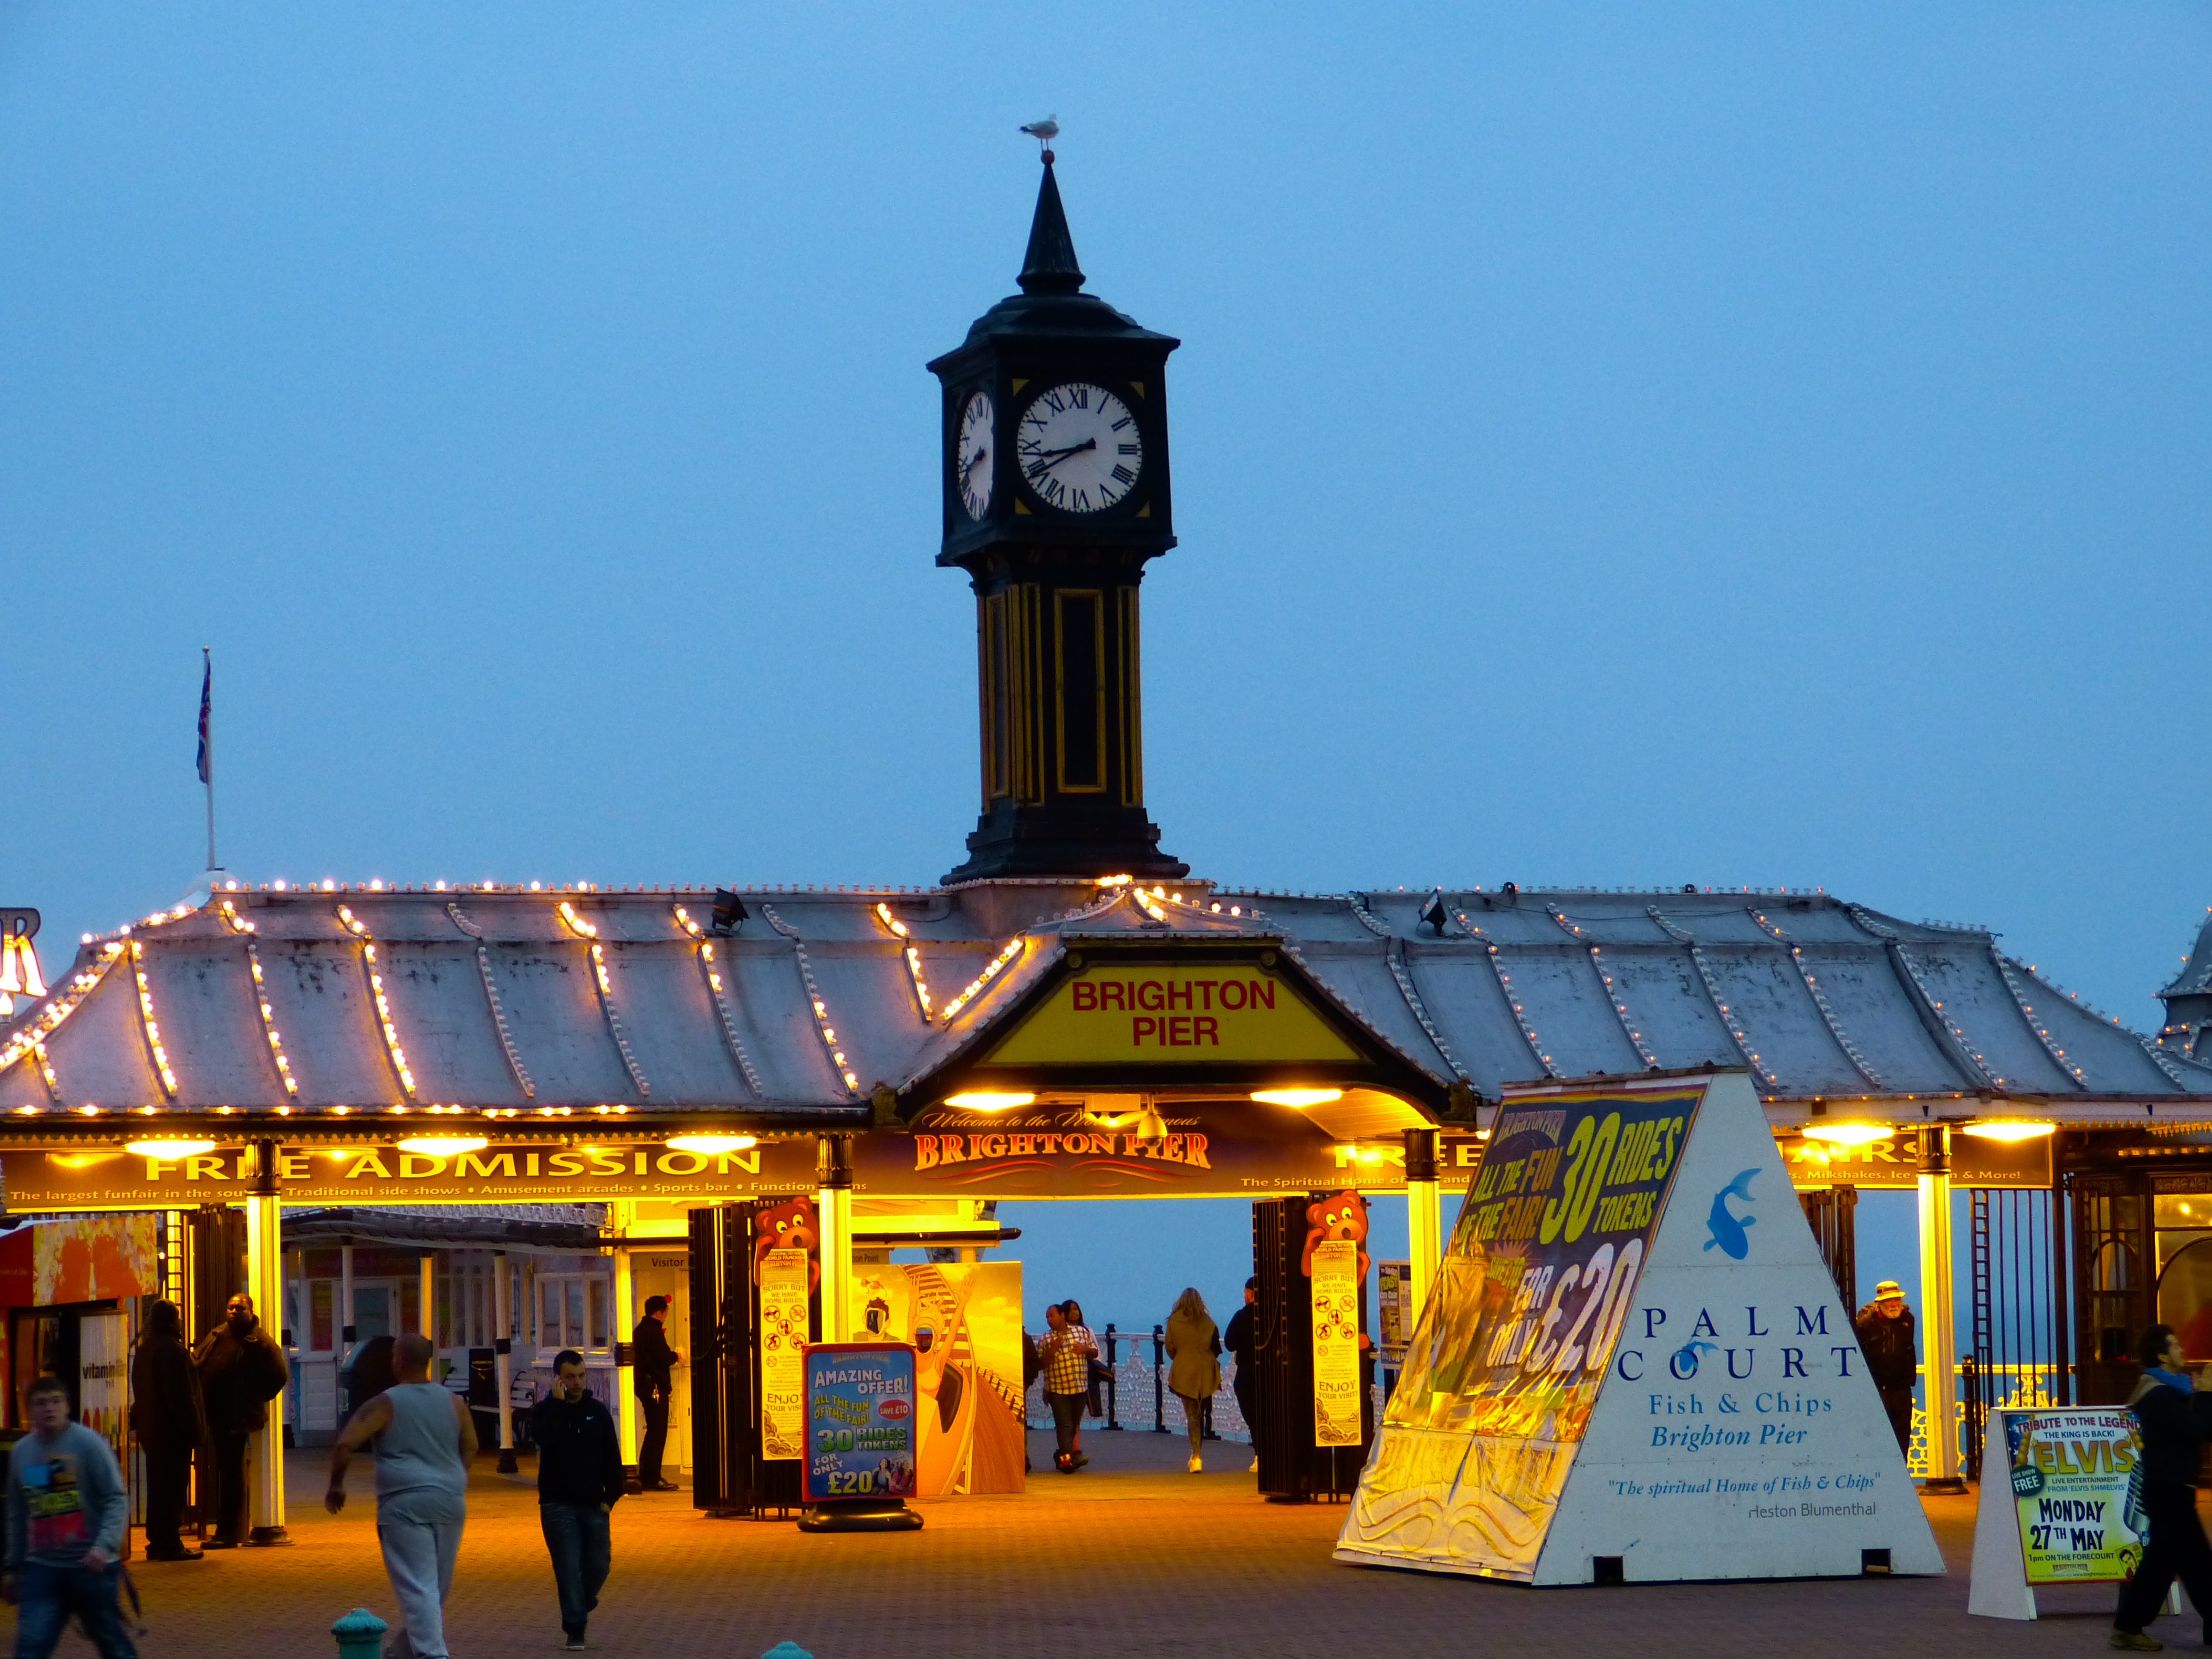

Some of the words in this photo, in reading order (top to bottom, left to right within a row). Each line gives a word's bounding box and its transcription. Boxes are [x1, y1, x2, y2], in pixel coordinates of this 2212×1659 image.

[1072, 980, 1275, 1011] BRIGHTON
[1133, 1016, 1219, 1046] PIER
[922, 1112, 1005, 1128] Welcome
[1006, 1115, 1020, 1127] to
[1022, 1113, 1051, 1127] the
[914, 1133, 1117, 1171] BRIGHTON
[1334, 1144, 1484, 1167] FRE
[1606, 1116, 1683, 1186] RIDES
[146, 1156, 311, 1181] FRE
[345, 1151, 761, 1178] ADMISSION
[1807, 1170, 1886, 1180] Milkshakes,
[1891, 1170, 1911, 1180] Ice
[1963, 1171, 1974, 1179] &
[1979, 1170, 2021, 1180] More!
[1240, 1178, 1269, 1187] The
[1274, 1177, 1335, 1187] Spiritual
[1338, 1177, 1385, 1187] Home
[1390, 1176, 1405, 1185] of
[1443, 1175, 1470, 1184] and
[1469, 1165, 1500, 1205] ALL
[1496, 1158, 1526, 1196] THE
[1519, 1146, 1564, 1194] FUN
[1540, 1112, 1620, 1244] 30
[286, 1187, 373, 1197] Traditional
[379, 1187, 409, 1196] side
[414, 1186, 460, 1195] shows
[481, 1185, 572, 1194] Amusement
[577, 1184, 634, 1193] arcades
[654, 1183, 700, 1193] Sports
[705, 1183, 731, 1192] bar
[750, 1182, 815, 1191] Function
[11, 1191, 40, 1201] The
[47, 1191, 99, 1202] largest
[105, 1190, 160, 1200] funfair
[165, 1190, 180, 1199] in
[186, 1190, 211, 1198] the
[1473, 1202, 1505, 1243] THE
[1494, 1194, 1550, 1240] FAIR!
[1592, 1191, 1657, 1234] TOKENS
[651, 1257, 684, 1267] Visitor
[864, 1254, 879, 1262] Point
[763, 1284, 788, 1293] SORRY
[791, 1284, 806, 1292] BUT
[1314, 1275, 1338, 1284] SORRY
[1511, 1265, 1554, 1313] FOR
[1525, 1238, 1643, 1373] £20
[1642, 1306, 1830, 1338] PALM
[1618, 1347, 1857, 1381] COURT
[815, 1369, 881, 1389] AMAZING
[858, 1374, 908, 1394] OFFER!
[1319, 1380, 1356, 1392] ENJOY
[767, 1393, 802, 1404] ENJO
[814, 1394, 830, 1407] ALL
[832, 1395, 849, 1410] THE
[852, 1399, 869, 1412] FUN
[1318, 1391, 1337, 1400] YOUR
[1339, 1390, 1358, 1400] VISIT!
[1648, 1394, 1703, 1415] Fish
[1718, 1394, 1741, 1413] &
[1756, 1392, 1832, 1416] Chips
[765, 1404, 786, 1412] YOUR
[814, 1407, 825, 1420] OF
[827, 1407, 845, 1422] THE
[847, 1412, 870, 1426] FAIR!
[895, 1405, 908, 1414] £10
[857, 1427, 906, 1441] RIDES
[2016, 1417, 2061, 1434] TRIBUTE
[2065, 1417, 2077, 1426] TO
[2078, 1416, 2096, 1426] THE
[817, 1429, 854, 1452] 30
[857, 1439, 907, 1451] TOKENS
[1651, 1425, 1751, 1452] Brighton
[1759, 1423, 1808, 1444] Pier
[815, 1453, 838, 1466] FOR
[2034, 1440, 2135, 1475] ELVIS
[813, 1459, 843, 1476] ONLY
[2012, 1471, 2021, 1479] LIVE
[2022, 1468, 2036, 1477] SHOW
[828, 1470, 873, 1494] £20
[1648, 1479, 1712, 1498] spiritual
[1715, 1479, 1758, 1493] Home
[1763, 1477, 1778, 1494] of
[1781, 1475, 1811, 1491] Fish
[1817, 1477, 1829, 1489] &
[2013, 1475, 2040, 1492] FREE
[1749, 1503, 1797, 1519] Heston
[1801, 1502, 1876, 1517] Blumenthal
[2039, 1498, 2106, 1523] MONDAY
[2070, 1528, 2105, 1551] MAY
[2028, 1554, 2044, 1563] 1pm
